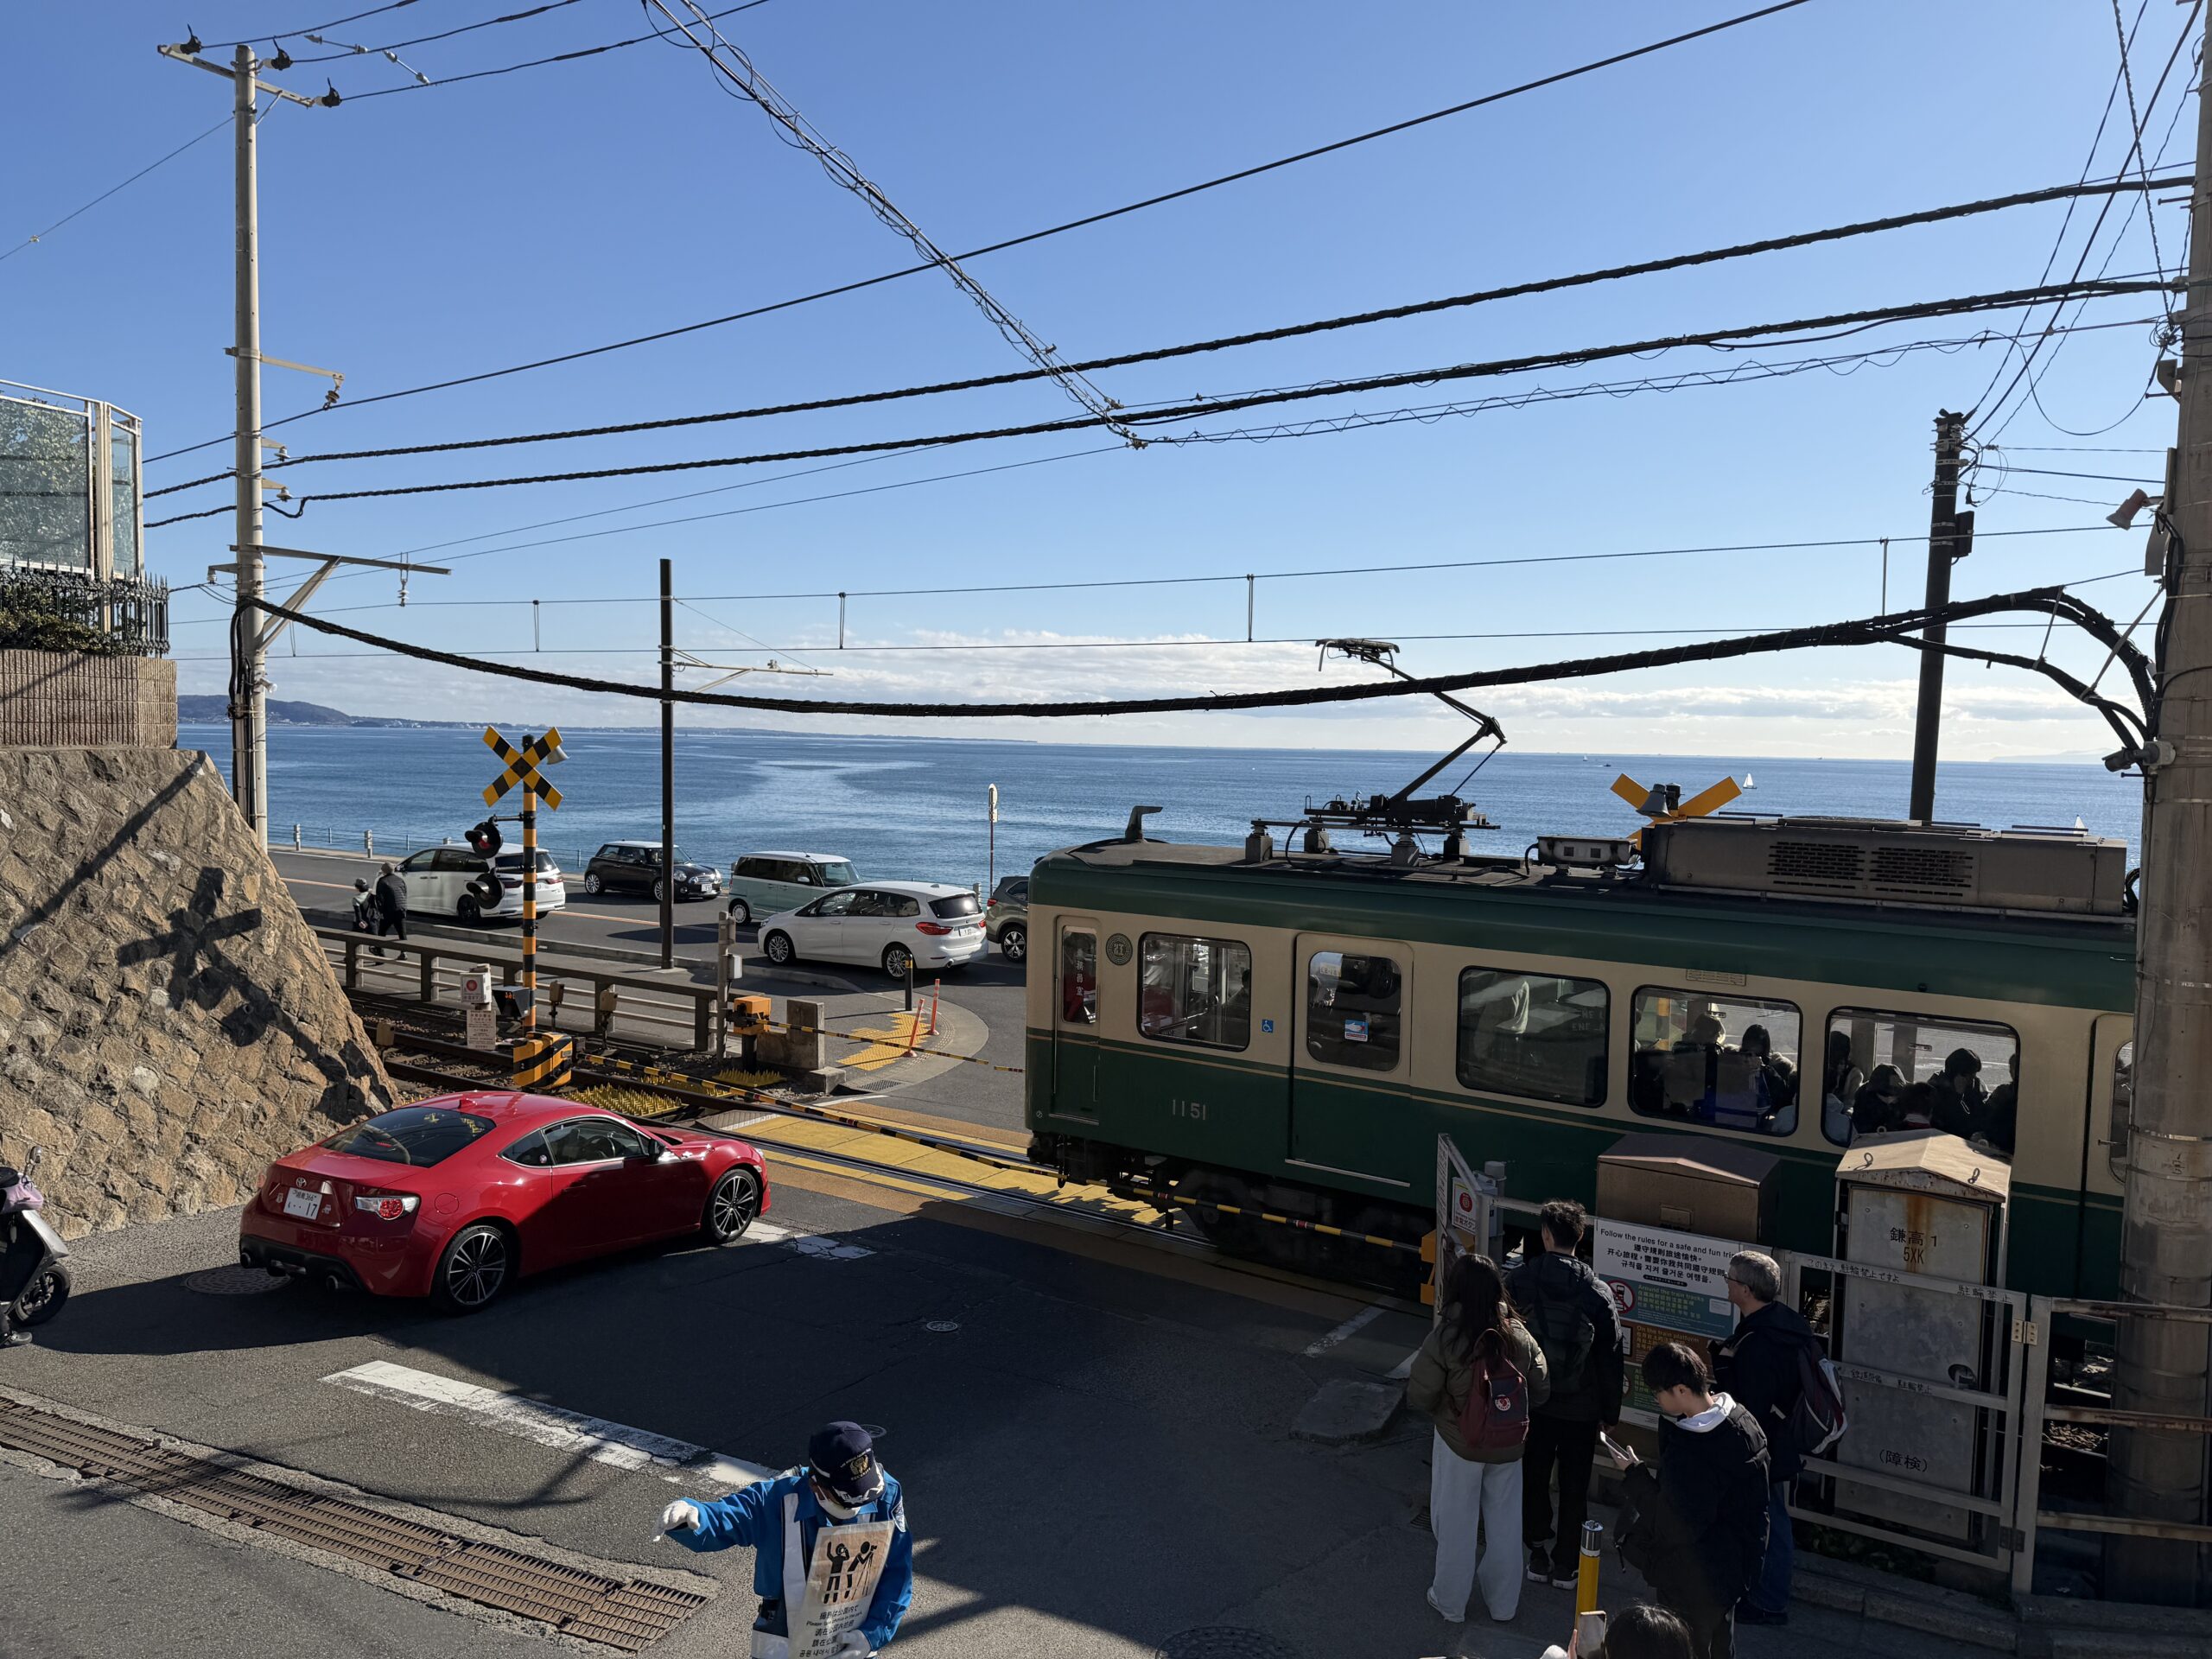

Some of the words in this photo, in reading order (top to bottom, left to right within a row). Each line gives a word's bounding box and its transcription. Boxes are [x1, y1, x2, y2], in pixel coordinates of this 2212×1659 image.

[1172, 1099, 1206, 1121] 1151
[1600, 1228, 1624, 1239] Follow
[1624, 1232, 1637, 1242] the
[1637, 1236, 1656, 1245] rules
[1657, 1238, 1669, 1247] for
[1675, 1243, 1692, 1252] safe
[1693, 1245, 1707, 1255] and
[1708, 1248, 1721, 1257] fun
[1890, 1227, 1924, 1246] 鎌高
[1903, 1246, 1924, 1265] 5XK
